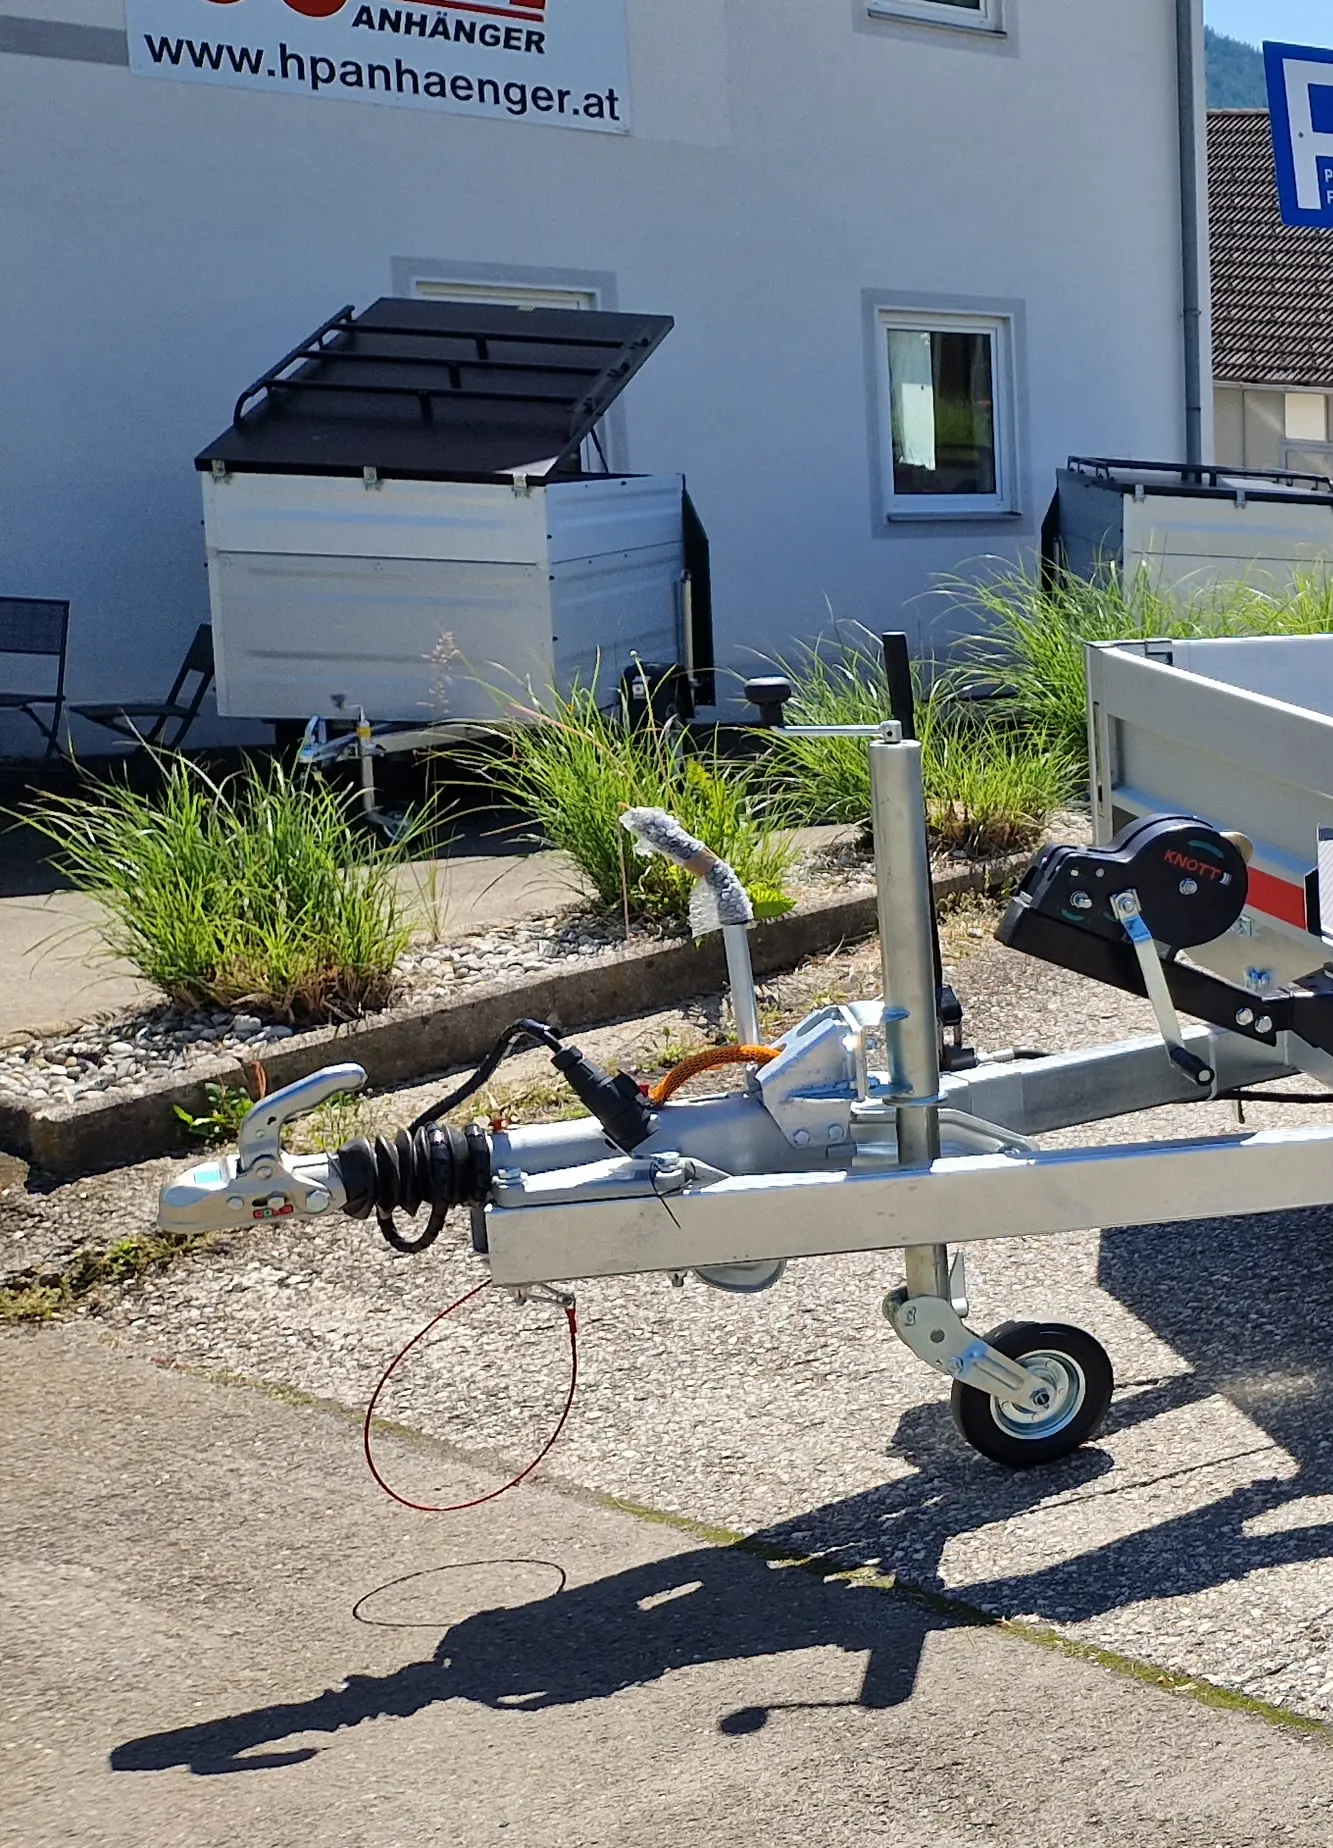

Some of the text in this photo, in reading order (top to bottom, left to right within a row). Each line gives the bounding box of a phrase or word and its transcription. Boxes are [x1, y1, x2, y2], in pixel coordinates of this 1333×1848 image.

[351, 4, 545, 54] ANHÄNGER
[143, 33, 620, 121] www.hpanhaenger.at
[1163, 848, 1221, 881] KNOTT
